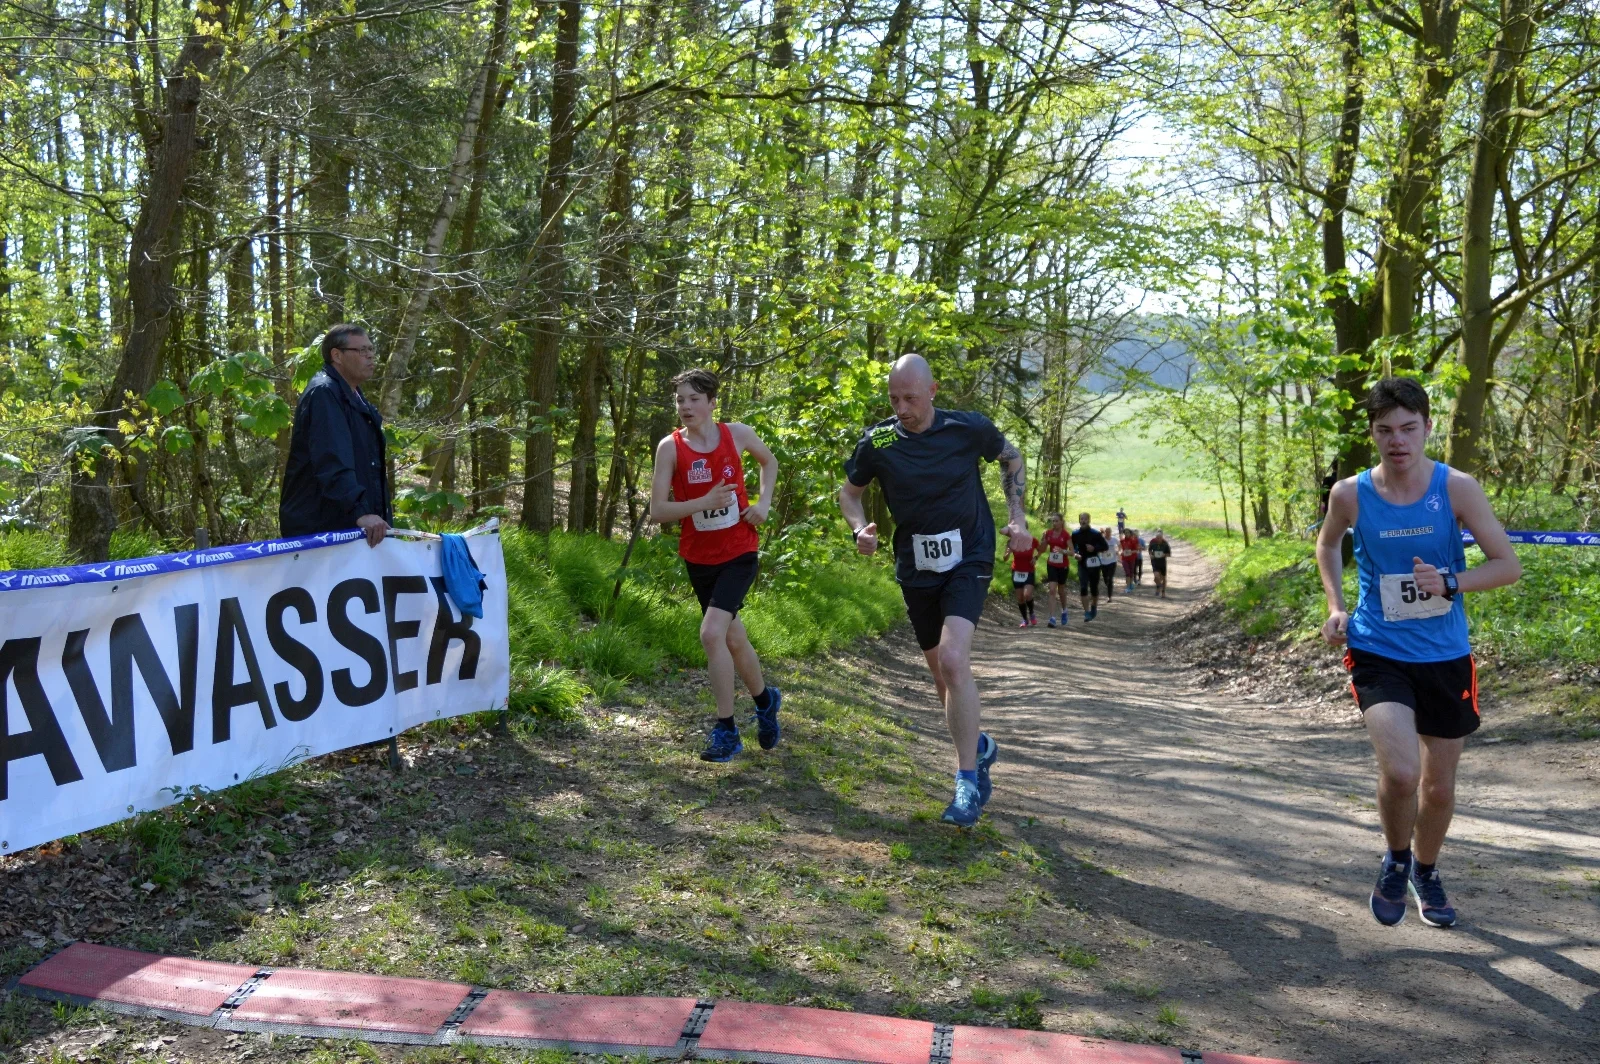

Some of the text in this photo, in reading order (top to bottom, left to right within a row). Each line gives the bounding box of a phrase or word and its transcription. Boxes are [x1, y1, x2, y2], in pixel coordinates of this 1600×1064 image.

[1387, 526, 1433, 537] EURAWASSER
[921, 537, 952, 560] 130
[0, 575, 483, 801] AWASSER
